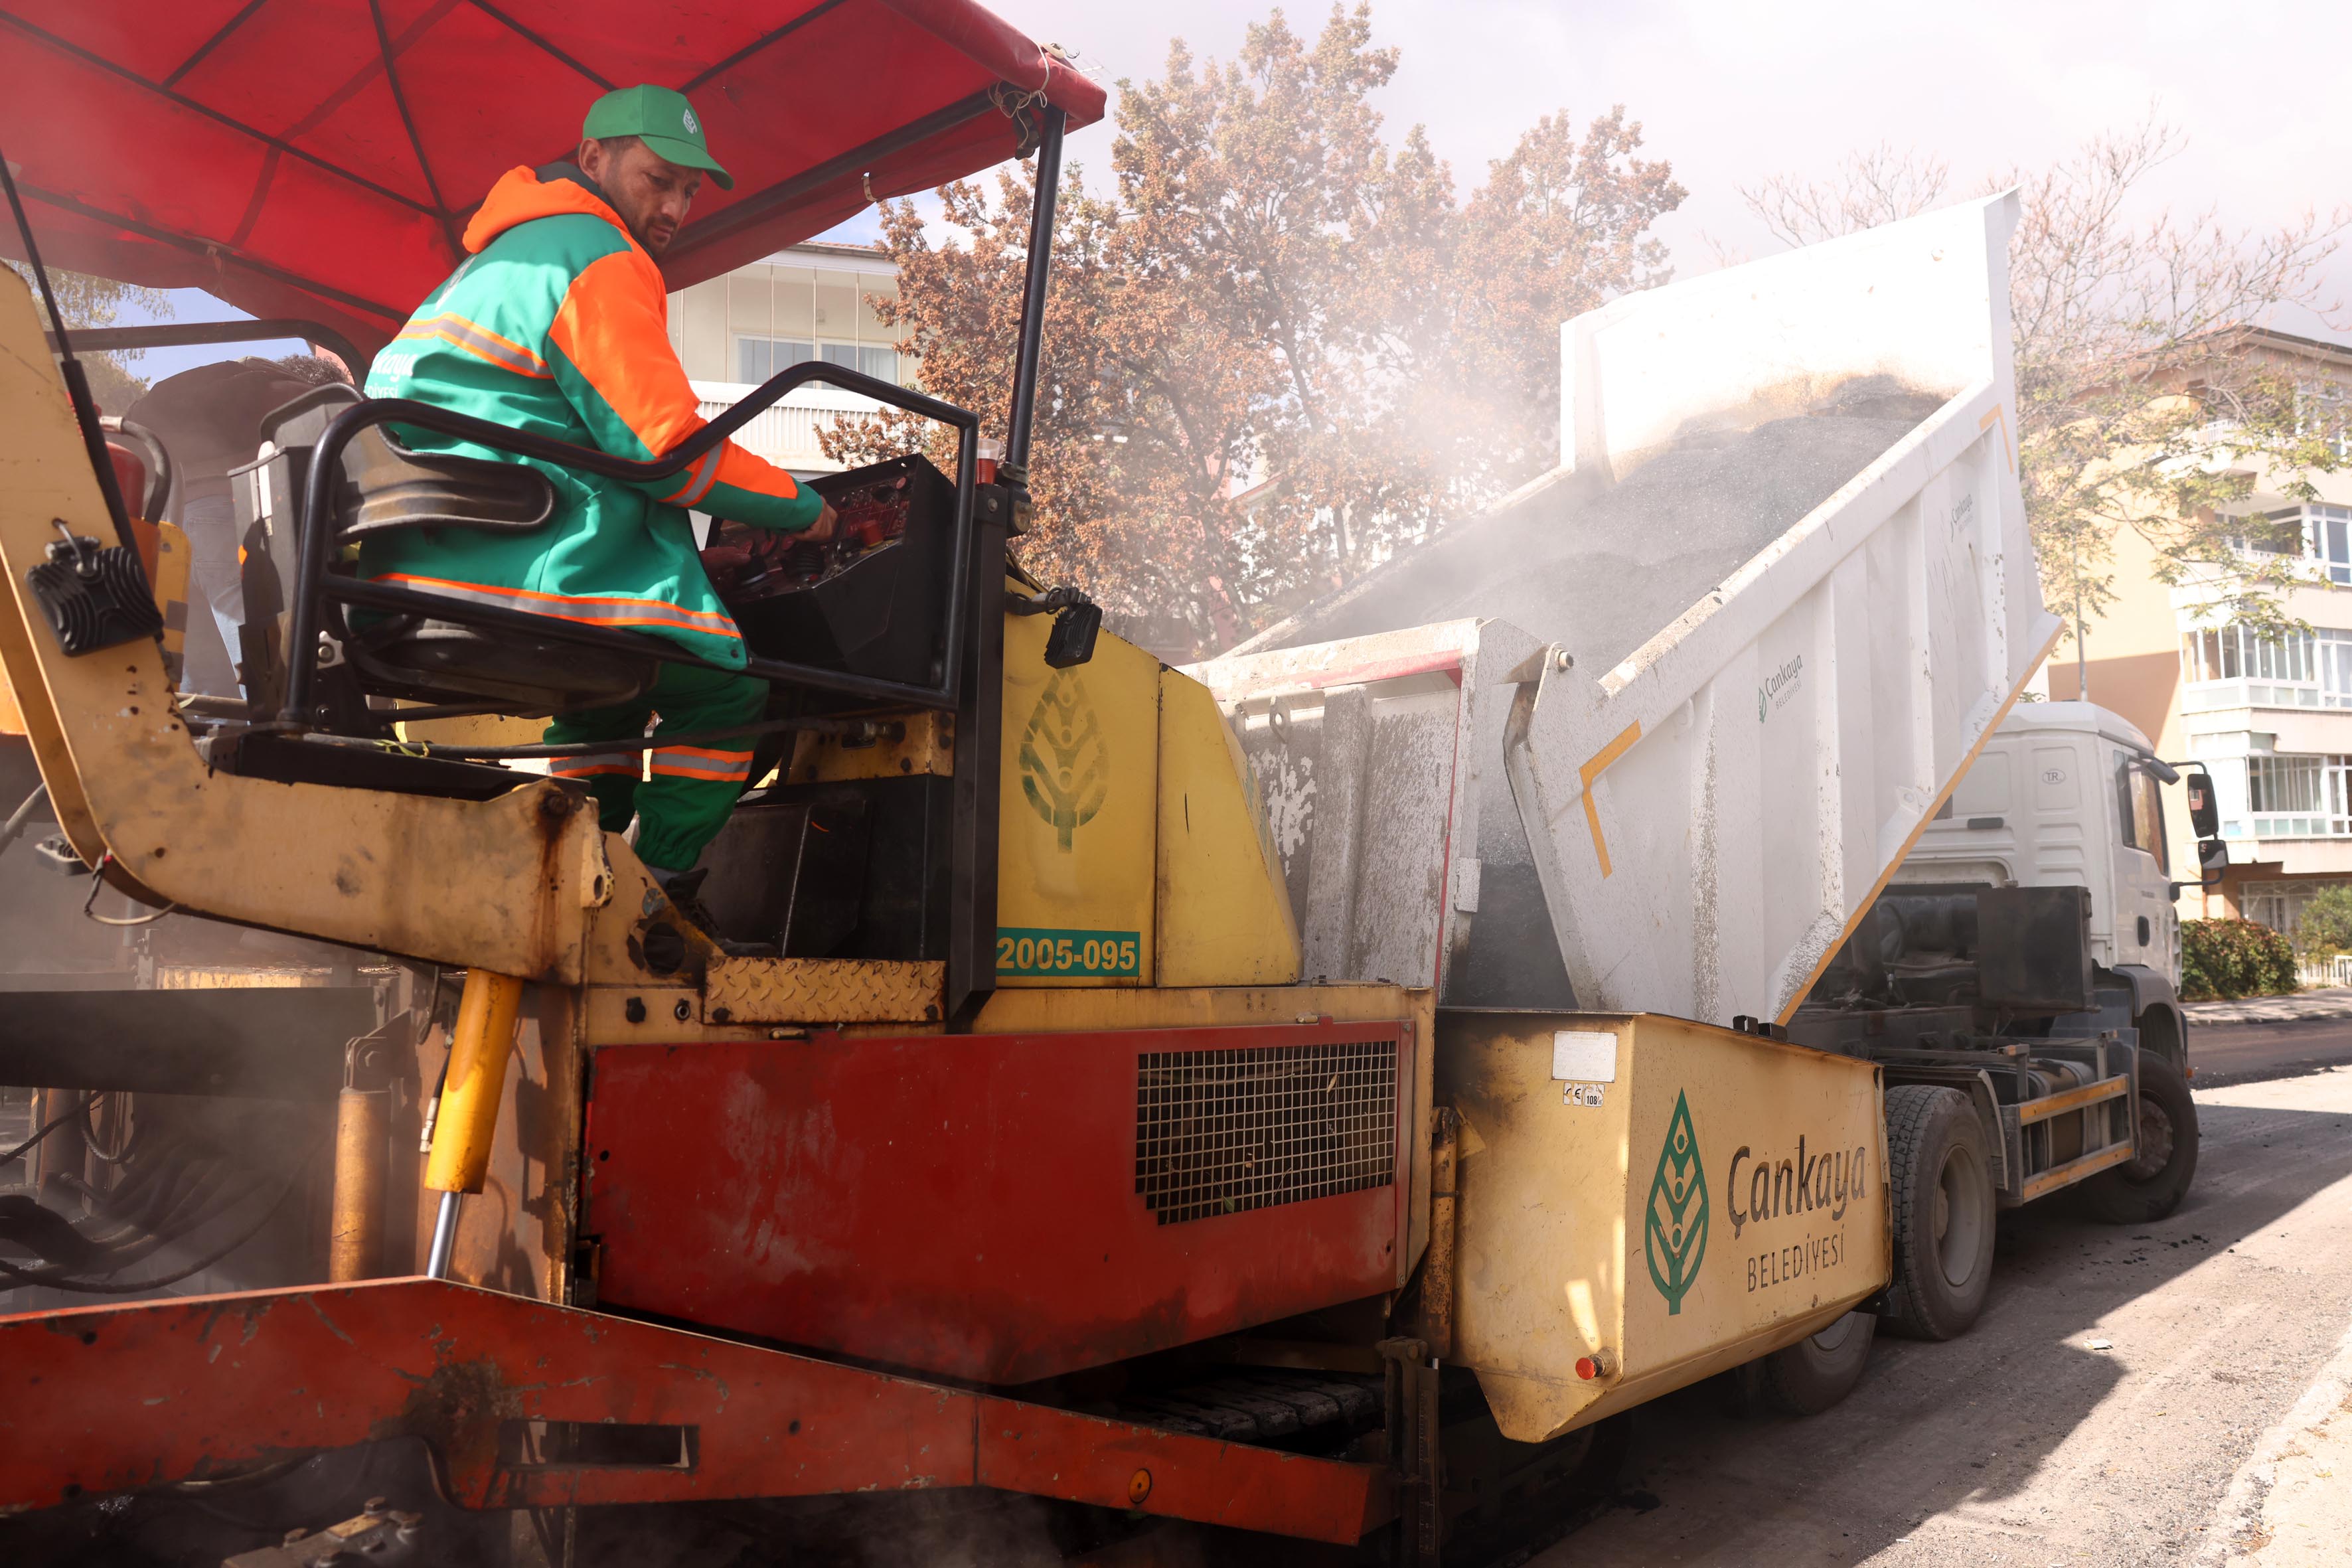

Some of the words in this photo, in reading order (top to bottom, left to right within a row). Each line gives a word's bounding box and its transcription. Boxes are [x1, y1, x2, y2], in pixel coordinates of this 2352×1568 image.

[1765, 654, 1803, 700] Çankaya
[1775, 678, 1802, 710] BELEDİYESİ
[996, 937, 1136, 970] 2005-095
[1587, 1095, 1597, 1105] 108
[1727, 1134, 1865, 1240] Çankaya
[1747, 1224, 1844, 1293] BELEDİYESİ
